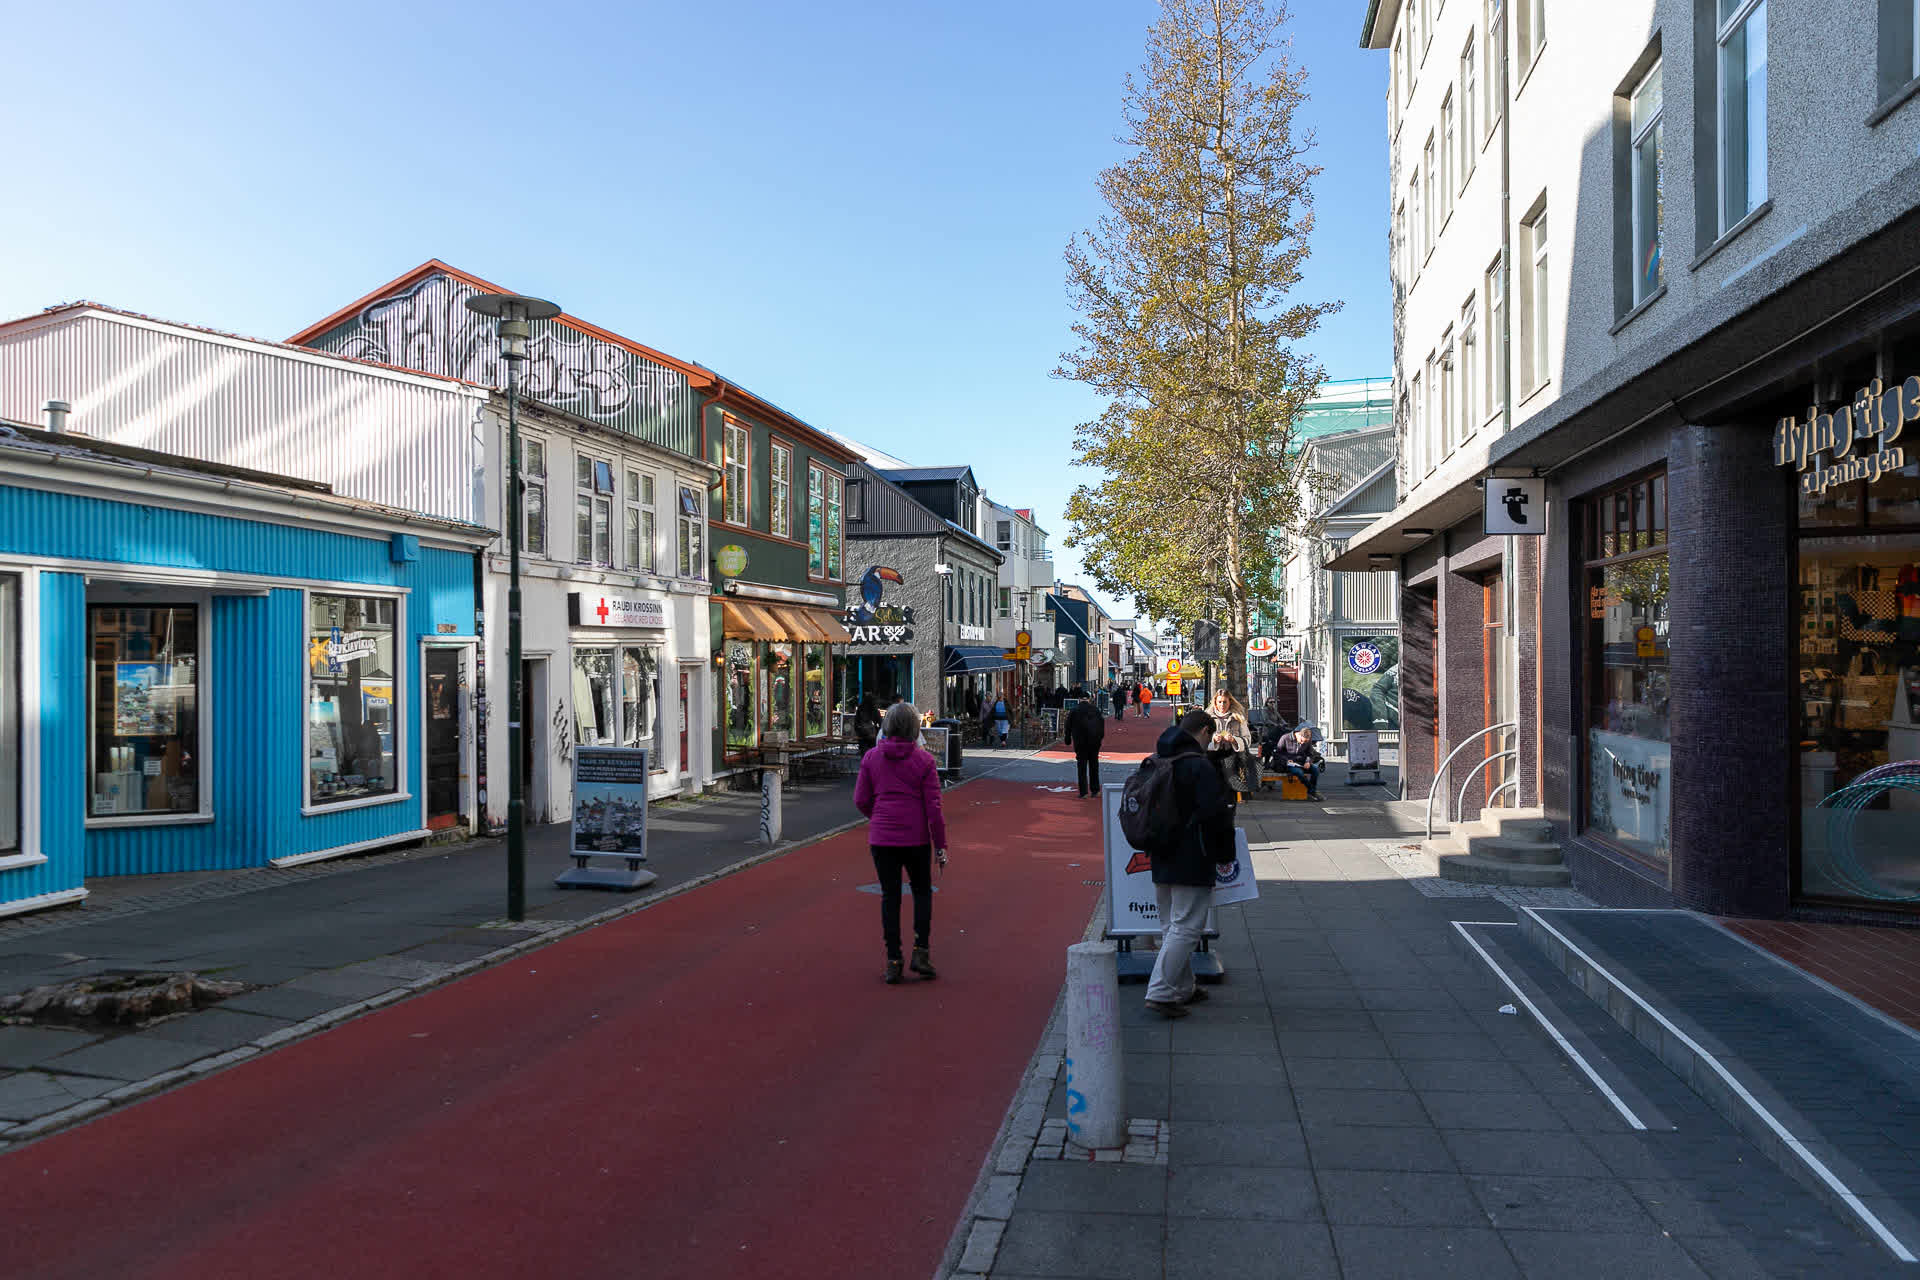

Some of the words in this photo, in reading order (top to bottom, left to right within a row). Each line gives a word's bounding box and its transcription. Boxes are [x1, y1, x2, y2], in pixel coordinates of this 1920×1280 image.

[1773, 406, 1853, 471] flying
[1801, 447, 1903, 494] copenhagen
[633, 602, 663, 614] KROSSINN
[1350, 642, 1380, 658] ICEWEAR
[1128, 902, 1160, 914] flyin
